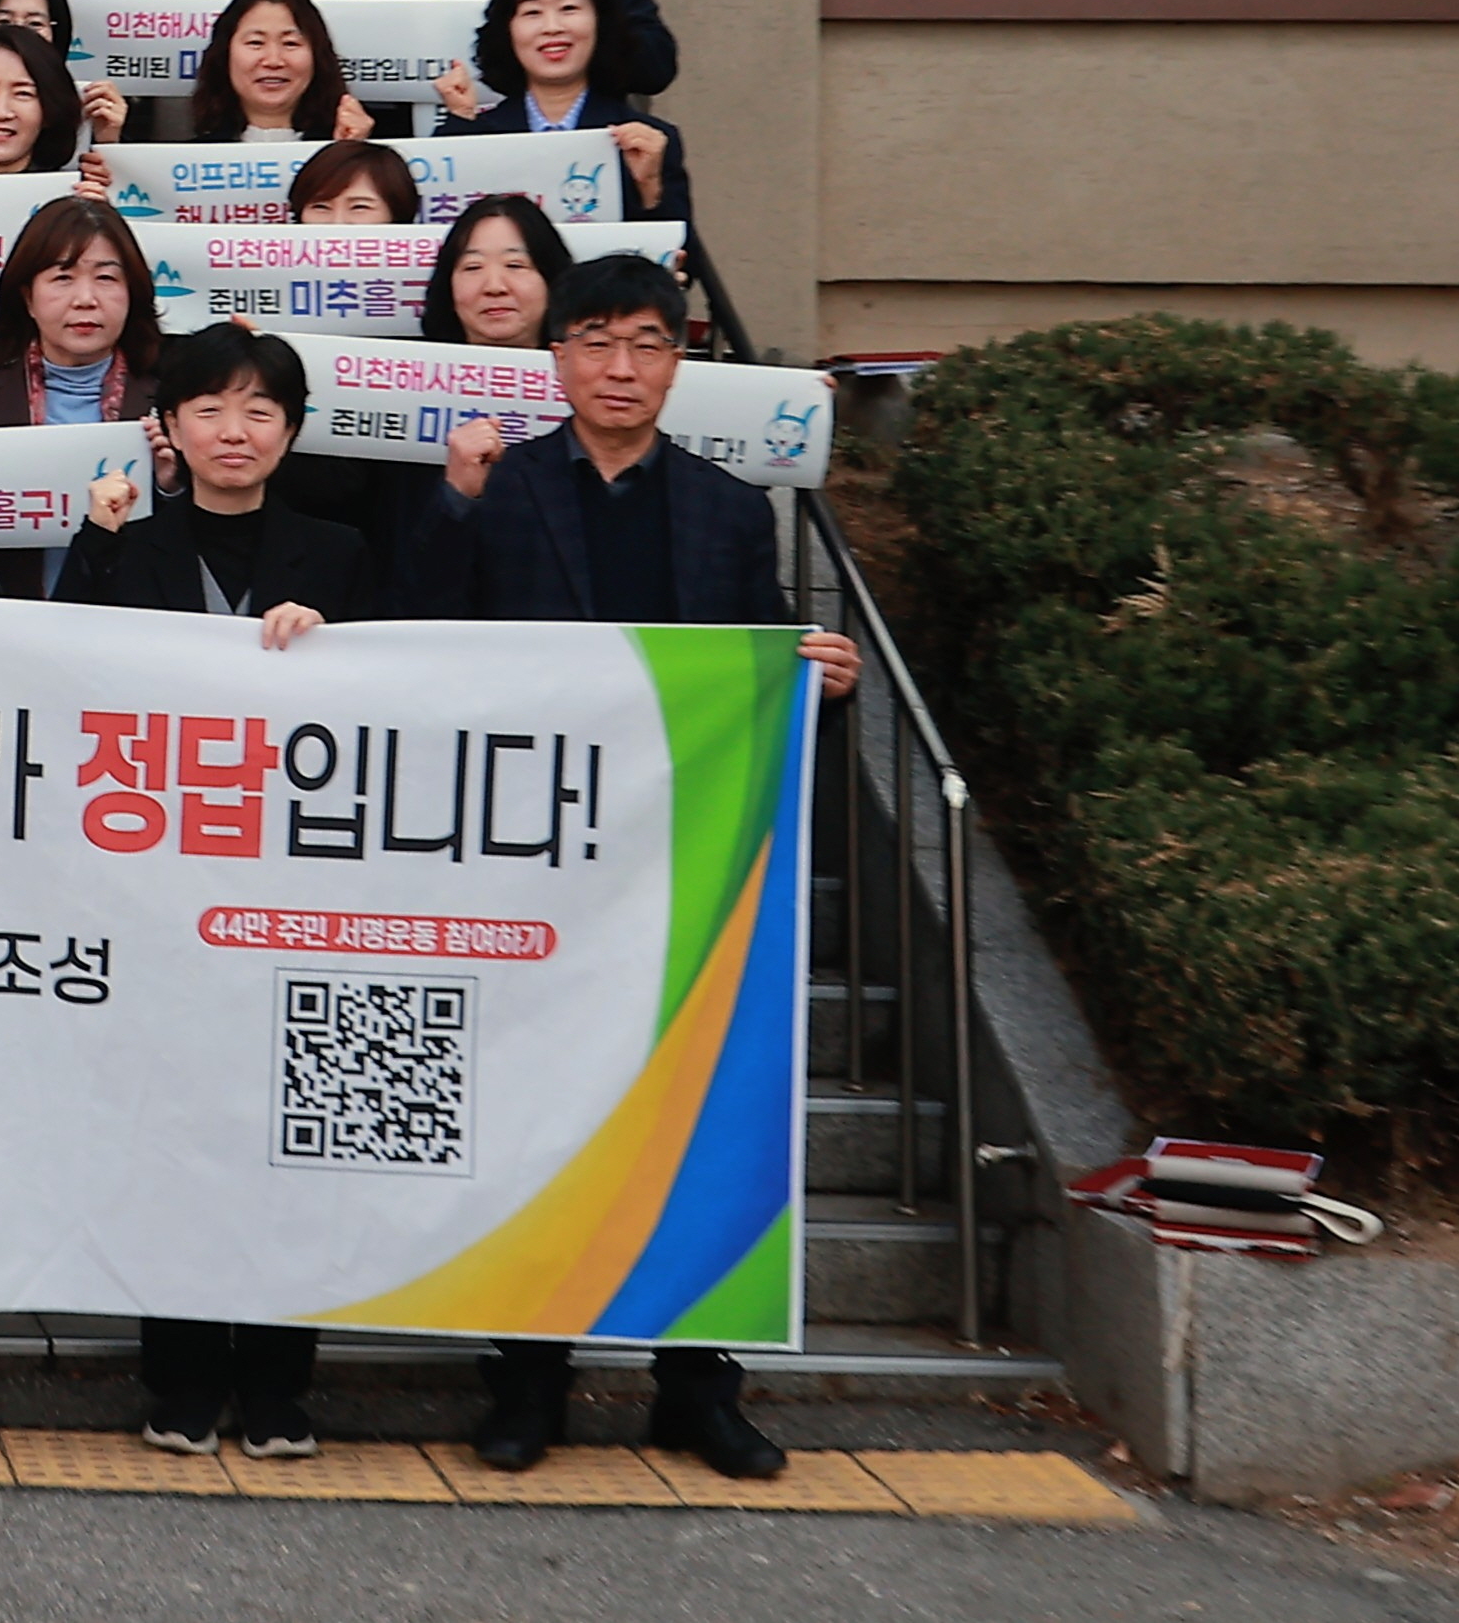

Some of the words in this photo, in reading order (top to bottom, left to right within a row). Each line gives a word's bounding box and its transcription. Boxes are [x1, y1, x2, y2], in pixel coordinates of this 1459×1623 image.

[106, 55, 169, 79] 준비된
[173, 157, 280, 192] 인프라도
[207, 238, 442, 270] 인천해사전문법원
[209, 289, 281, 316] 준비된
[331, 409, 407, 441] 준비된
[77, 710, 604, 868] 정답입니다!
[209, 911, 271, 946] 44만
[276, 913, 330, 947] 주민
[338, 917, 438, 951] 서명운동
[443, 921, 548, 957] 참여하기
